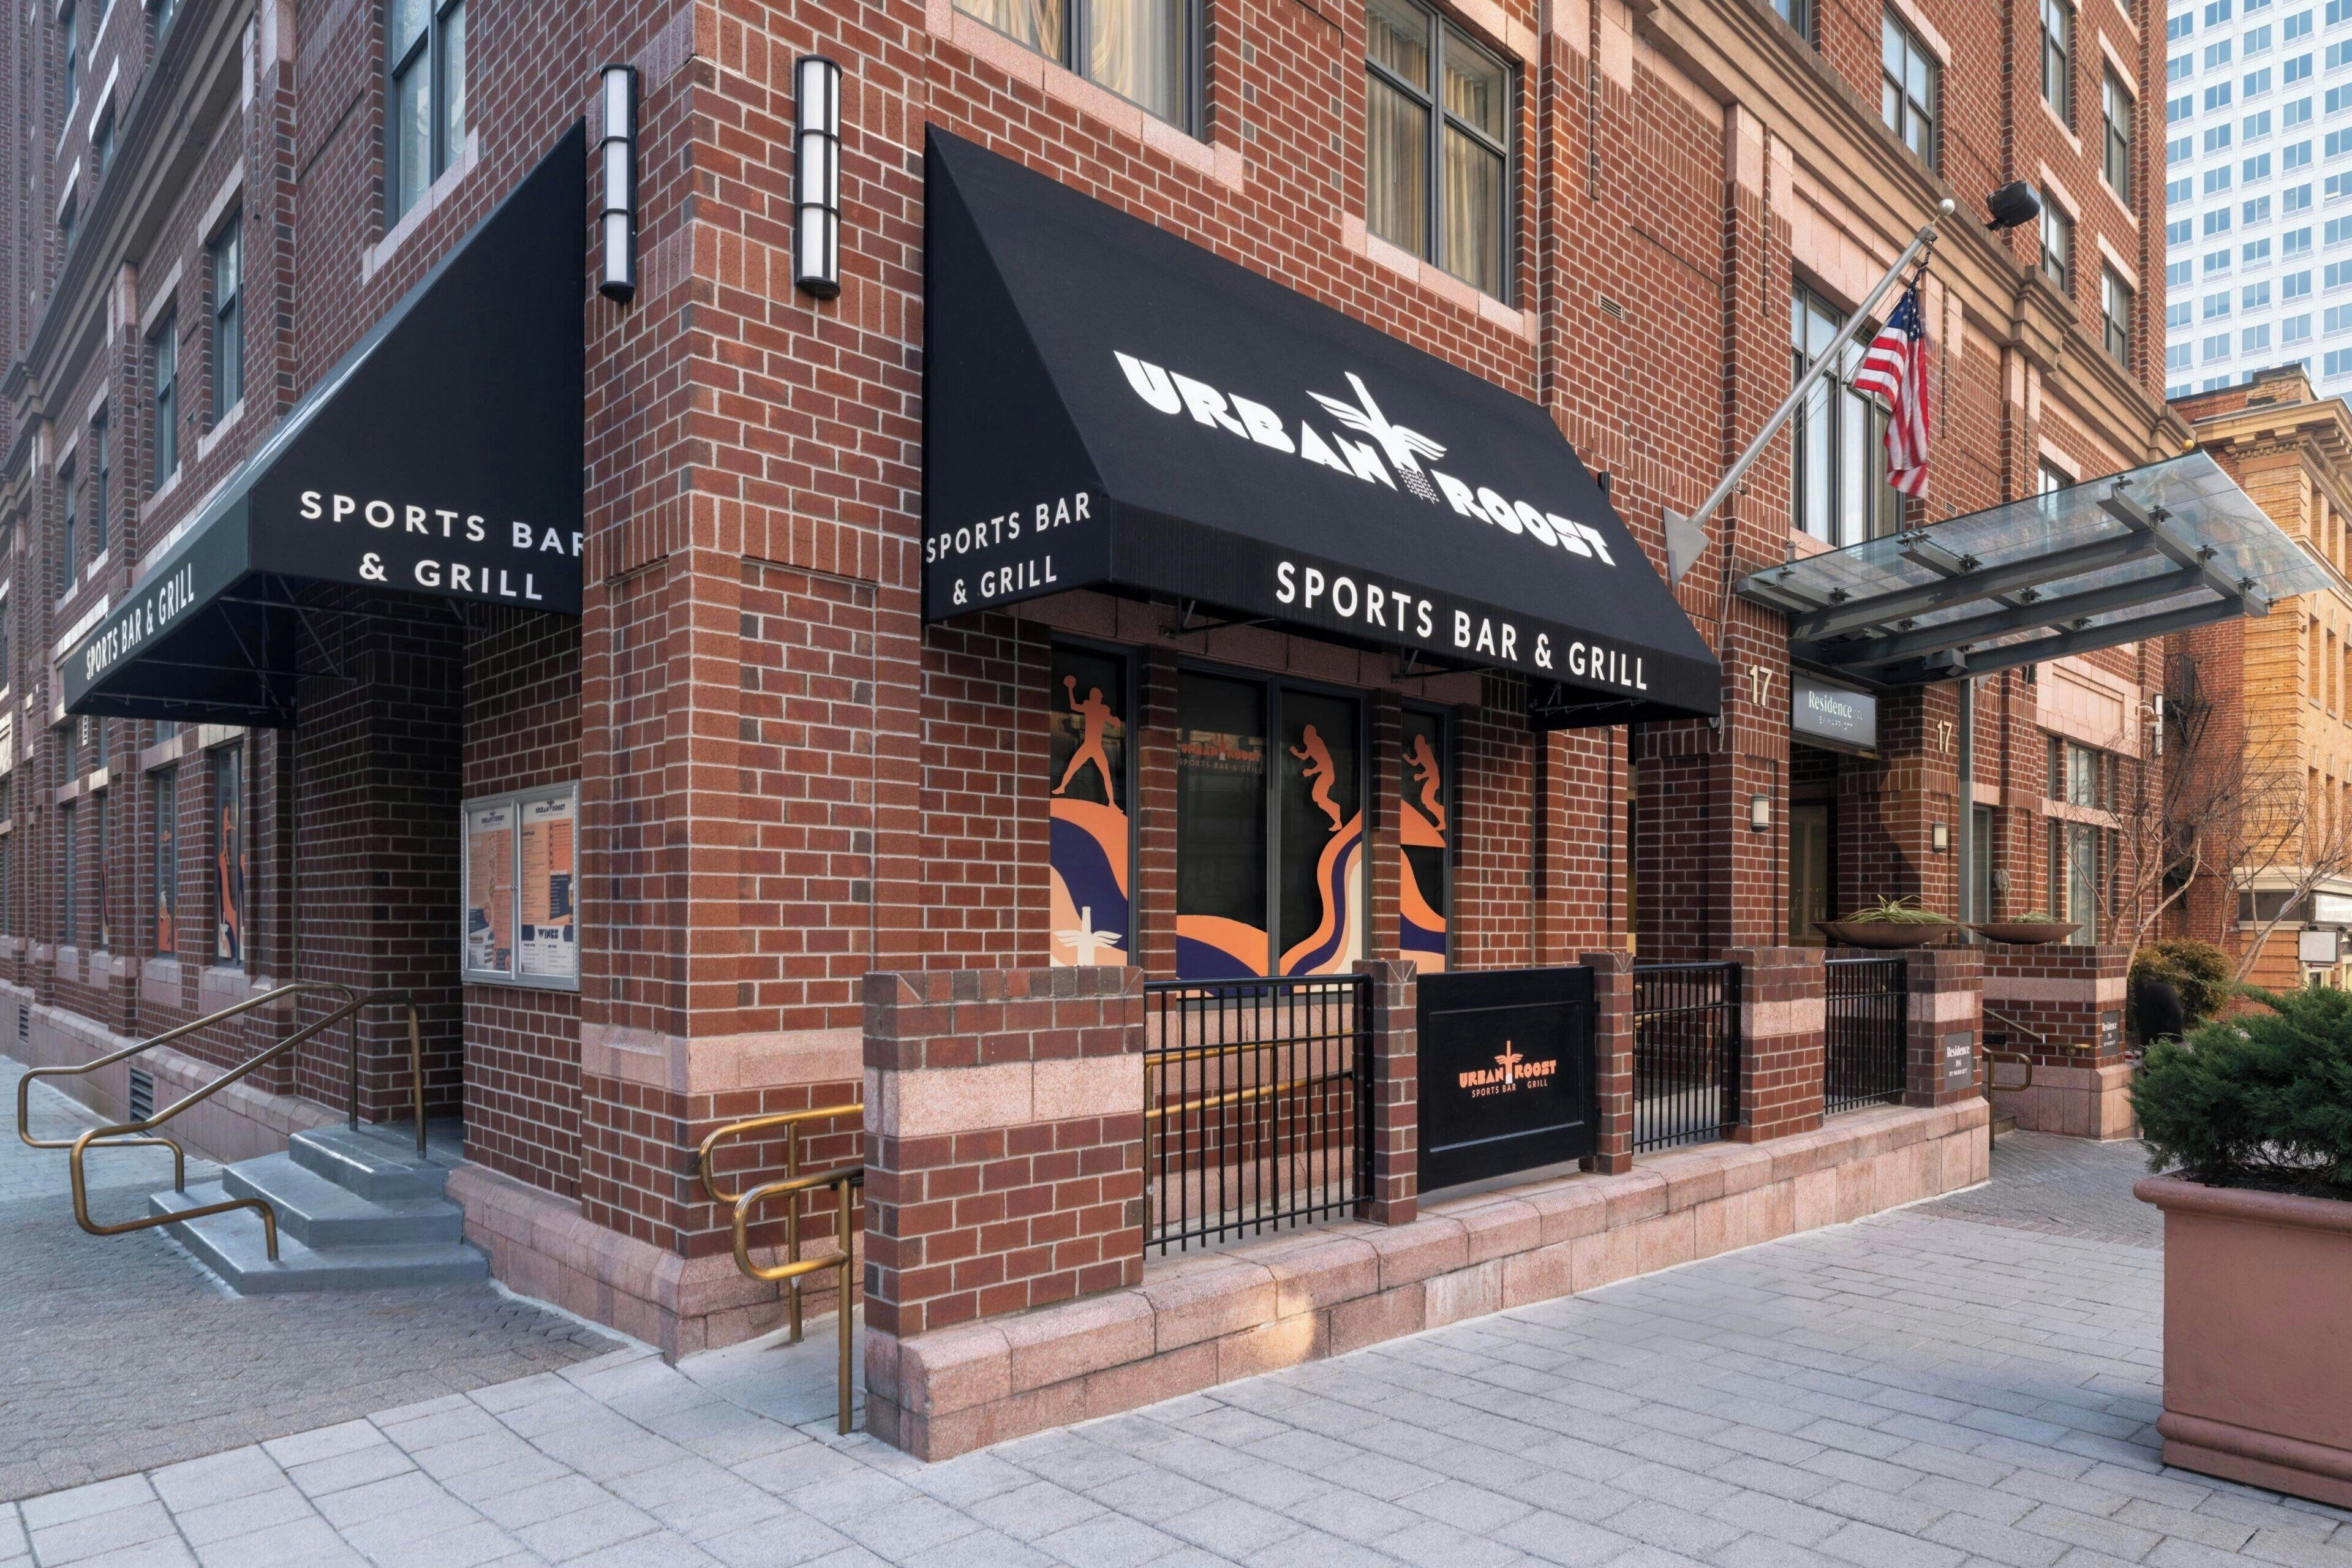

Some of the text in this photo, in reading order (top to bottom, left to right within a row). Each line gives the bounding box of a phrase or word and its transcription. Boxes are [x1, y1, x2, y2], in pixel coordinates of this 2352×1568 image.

[1114, 350, 1616, 566] URBAN ROOST
[300, 491, 485, 541] SPORTS
[925, 492, 1090, 564] SPORTS BAR
[359, 552, 542, 600] & GRILL
[953, 556, 1057, 605] & GRILL
[86, 563, 194, 680] SPORTS BAR & GRILL
[1276, 562, 1647, 690] SPORTS BAR & GRILL
[1750, 665, 1773, 706] 17
[1809, 690, 1852, 718] Residence
[1181, 743, 1218, 756] URBAN
[1937, 720, 1952, 752] 17
[1179, 758, 1210, 769] SPORTS
[1242, 766, 1262, 774] GRILL
[1947, 1045, 1970, 1058] Residence
[1459, 1060, 1556, 1088] URBAN ROOST
[1472, 1079, 1548, 1098] SPORTS BAR GRILL
